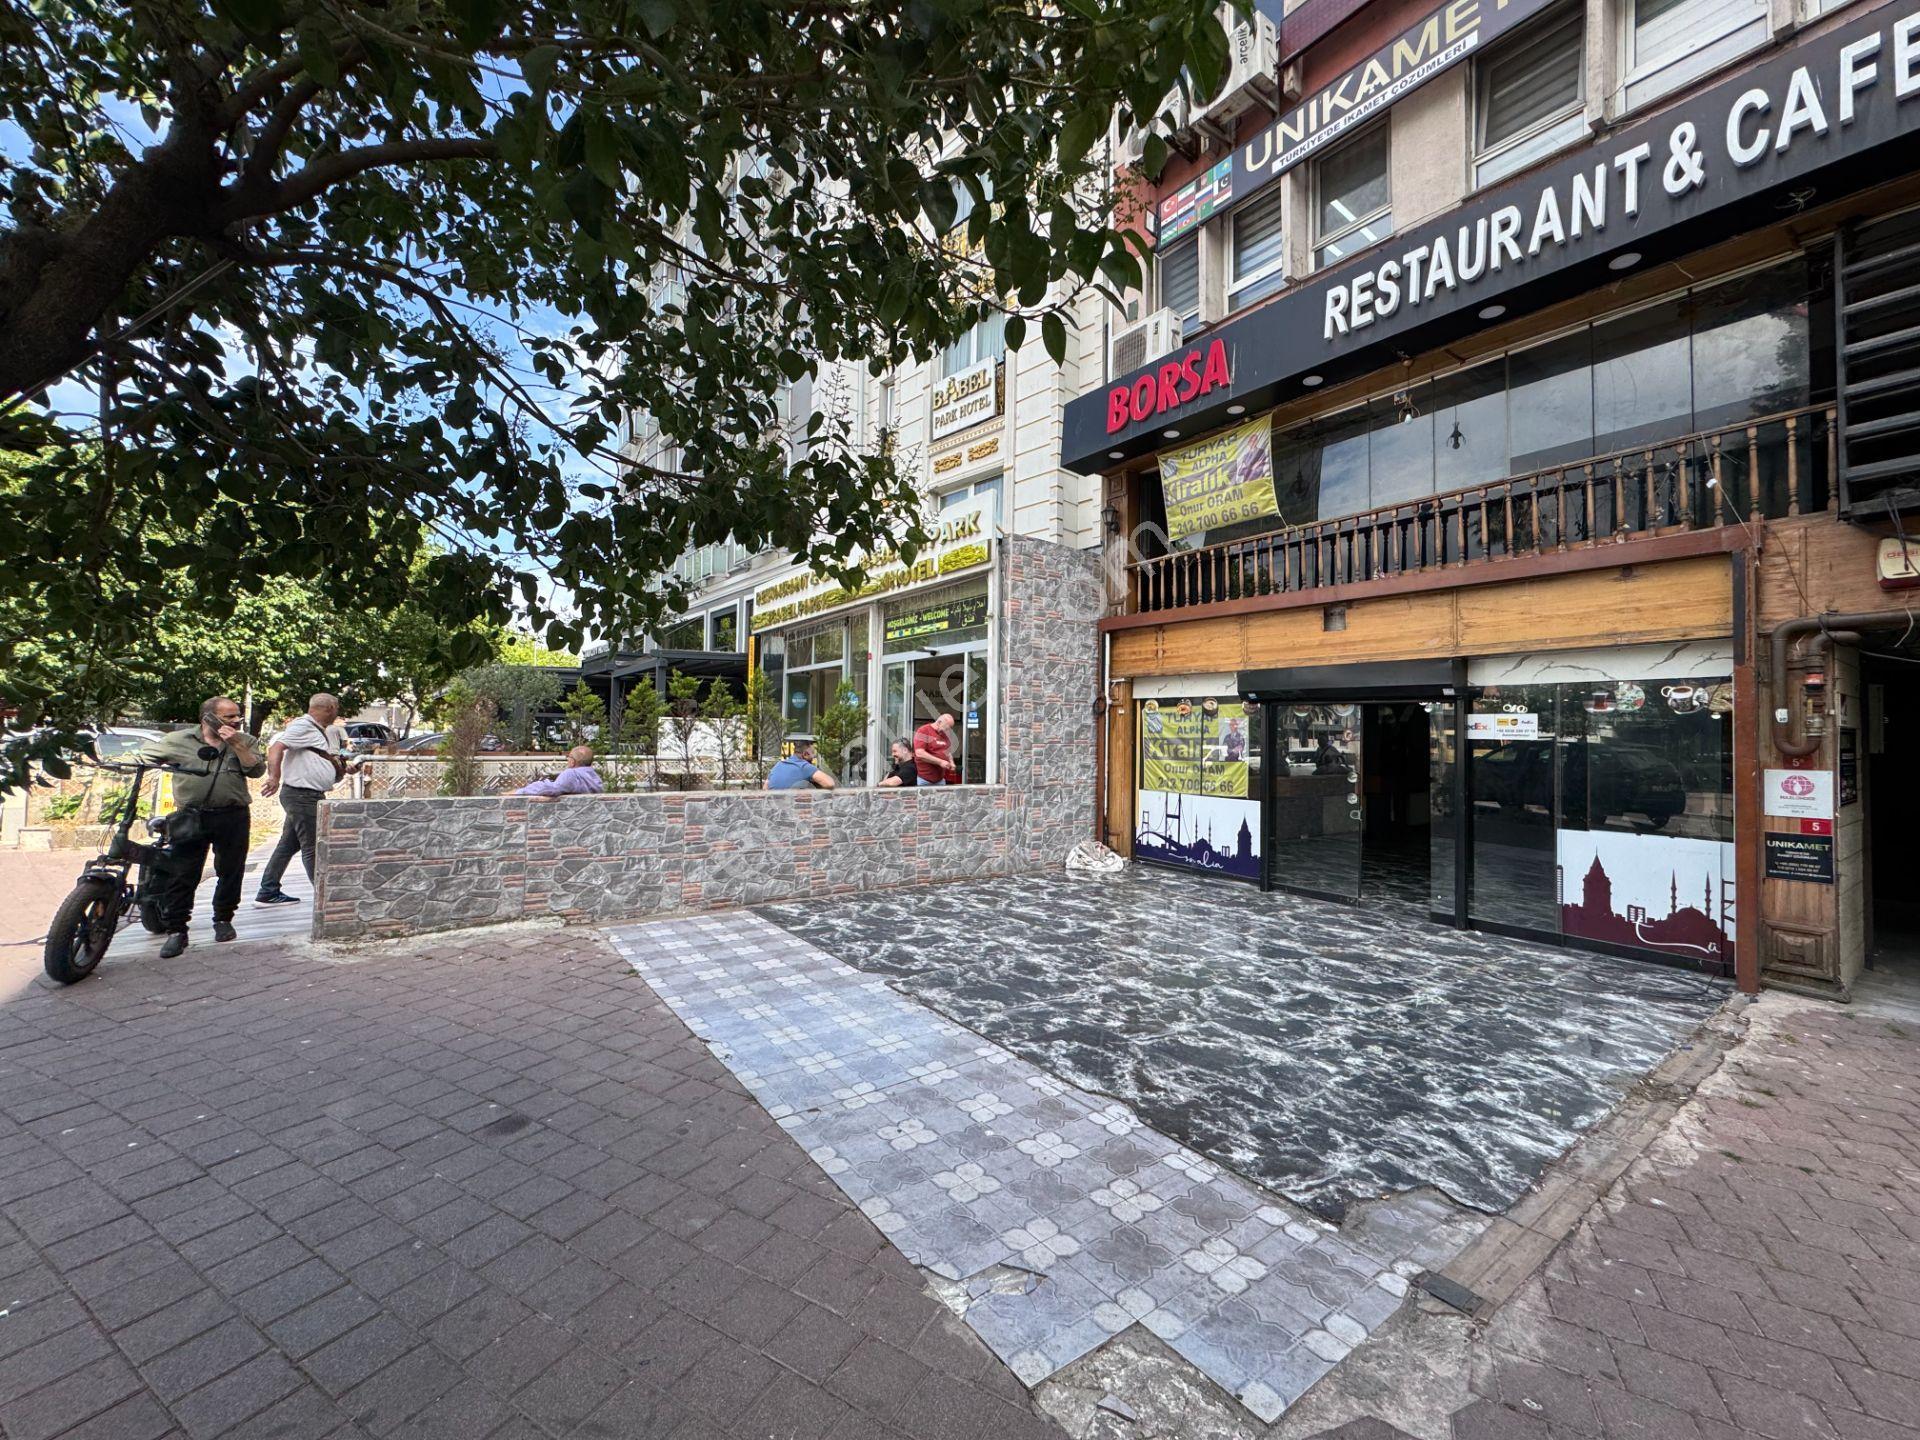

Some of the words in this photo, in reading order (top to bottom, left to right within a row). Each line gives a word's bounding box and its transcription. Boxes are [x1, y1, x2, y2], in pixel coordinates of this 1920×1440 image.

[1245, 0, 1508, 172] UNIKAME
[1324, 142, 1650, 341] RESTAURANT
[1663, 121, 1704, 196] &
[1726, 11, 1920, 168] CAFE
[1106, 338, 1231, 434] BORSA
[934, 407, 959, 429] PARK
[960, 394, 991, 418] HOTEL
[1192, 451, 1227, 471] ALPHA
[1178, 519, 1196, 535] 212
[1198, 512, 1218, 531] 700
[1221, 507, 1238, 525] 66
[1242, 502, 1259, 519] 66
[1180, 502, 1204, 517] Onur
[1207, 487, 1243, 509] ORAM
[1812, 822, 1820, 832] 5
[1767, 840, 1831, 852] UNIKAMET
